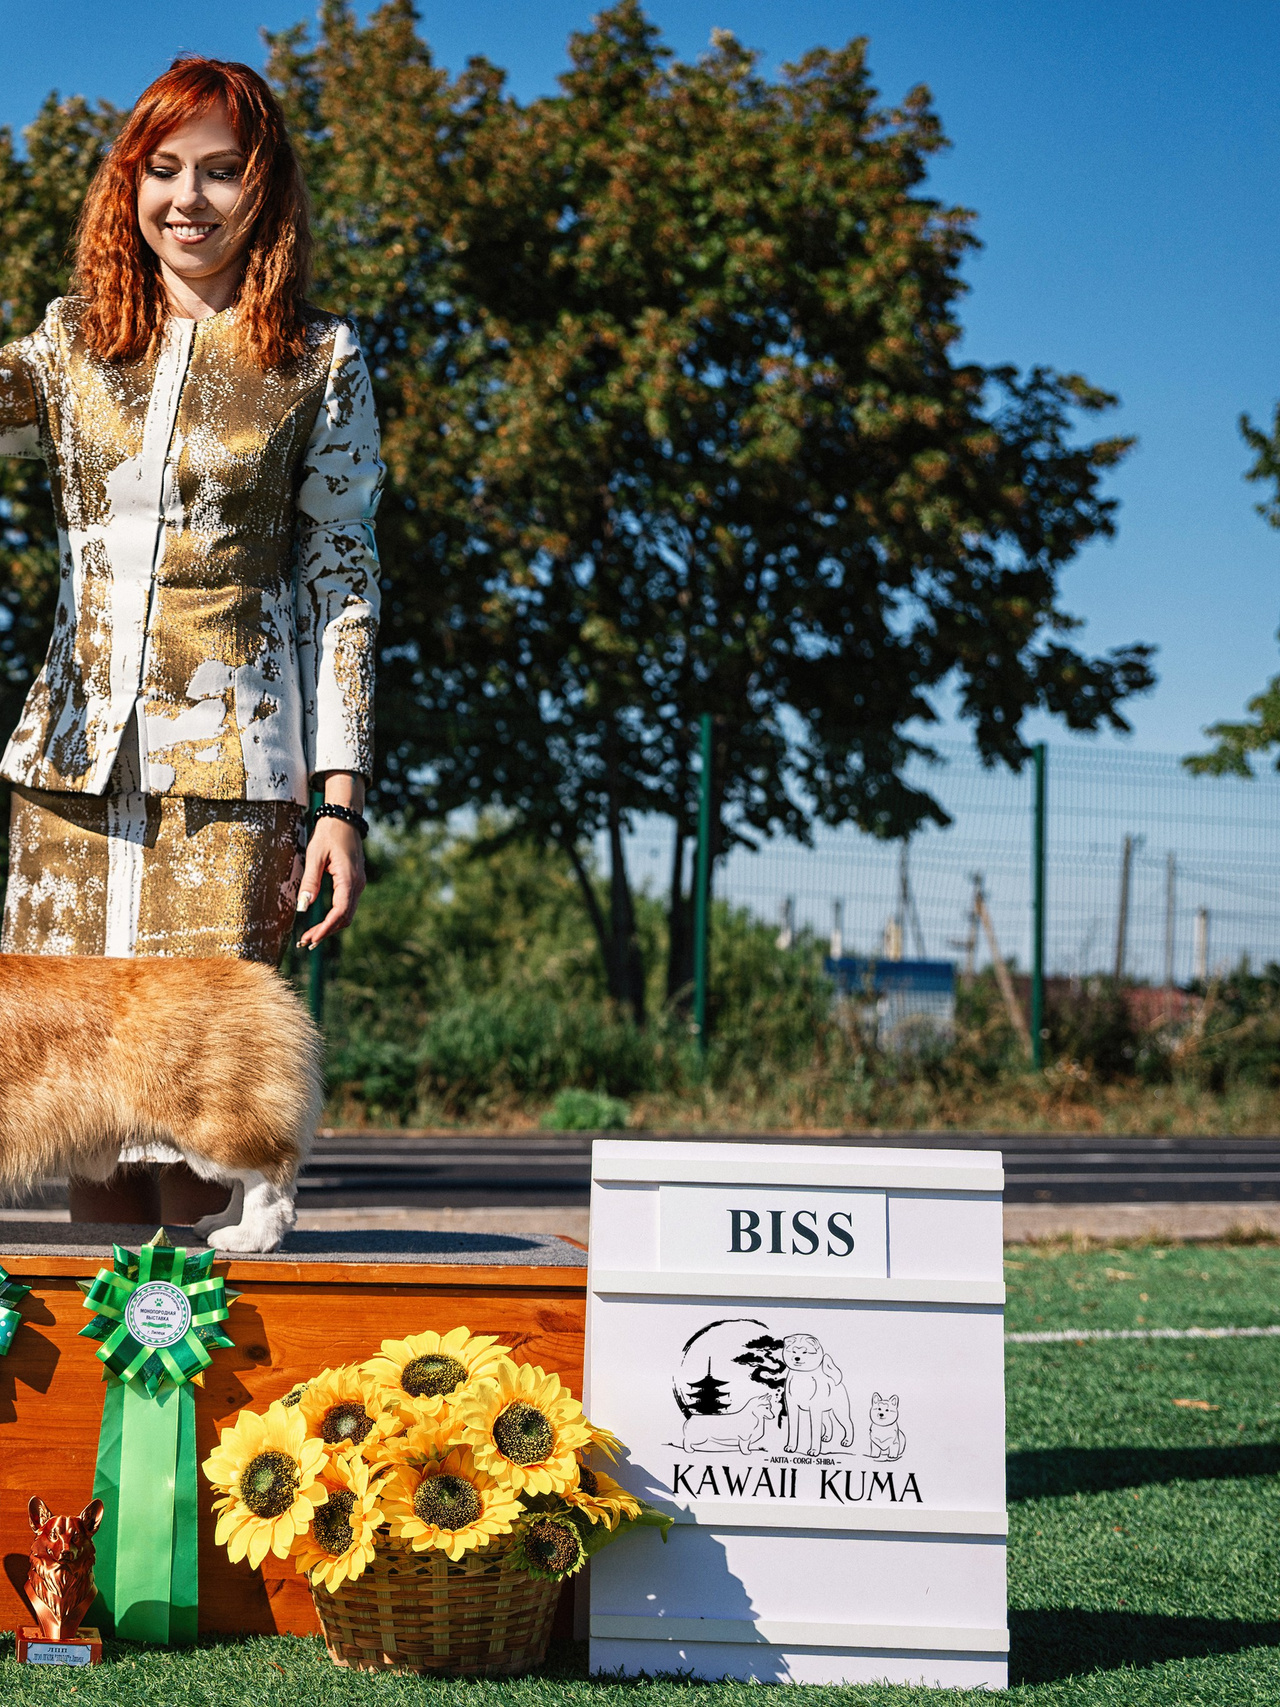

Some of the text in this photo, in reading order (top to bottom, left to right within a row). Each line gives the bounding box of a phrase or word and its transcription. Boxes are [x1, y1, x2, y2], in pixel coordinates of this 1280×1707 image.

[726, 1209, 855, 1257] BISS
[770, 1456, 835, 1466] AKITA CORGI SHIBA
[672, 1464, 923, 1505] KAWAII KUMA
